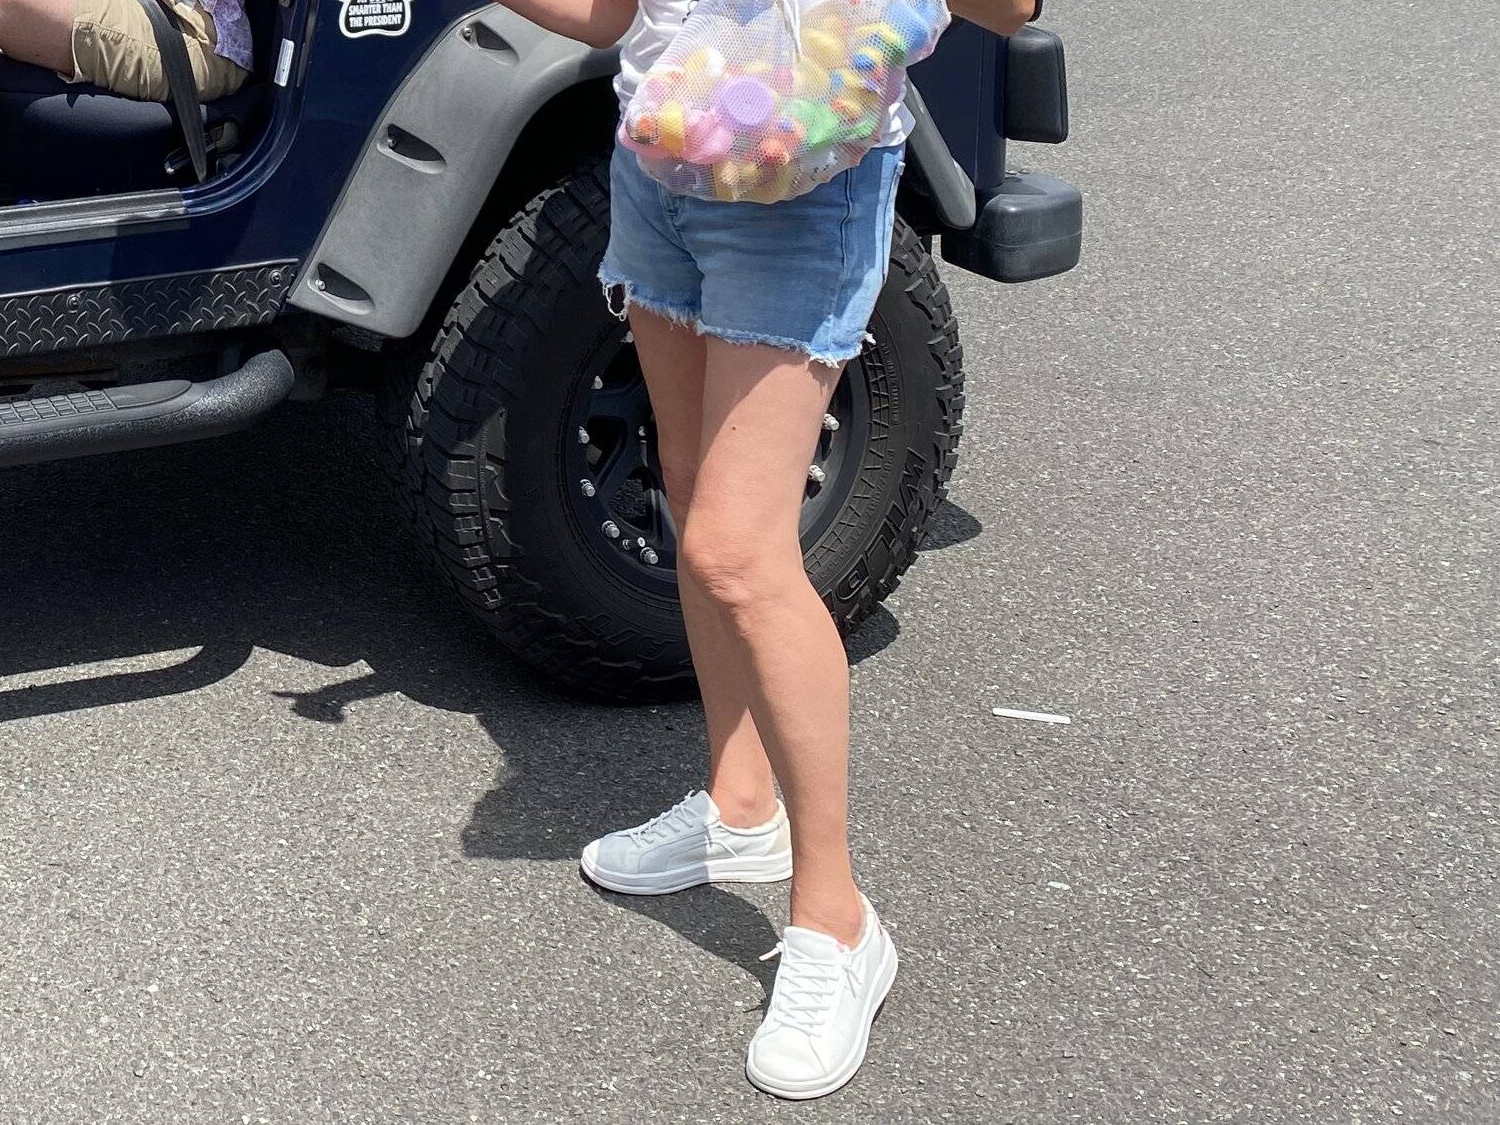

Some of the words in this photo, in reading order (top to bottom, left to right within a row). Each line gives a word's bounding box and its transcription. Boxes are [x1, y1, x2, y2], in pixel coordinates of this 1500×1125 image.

[348, 3, 381, 16] SMARTER
[382, 2, 403, 13] THAN
[349, 17, 364, 28] THE
[364, 14, 402, 26] PRESIDENT
